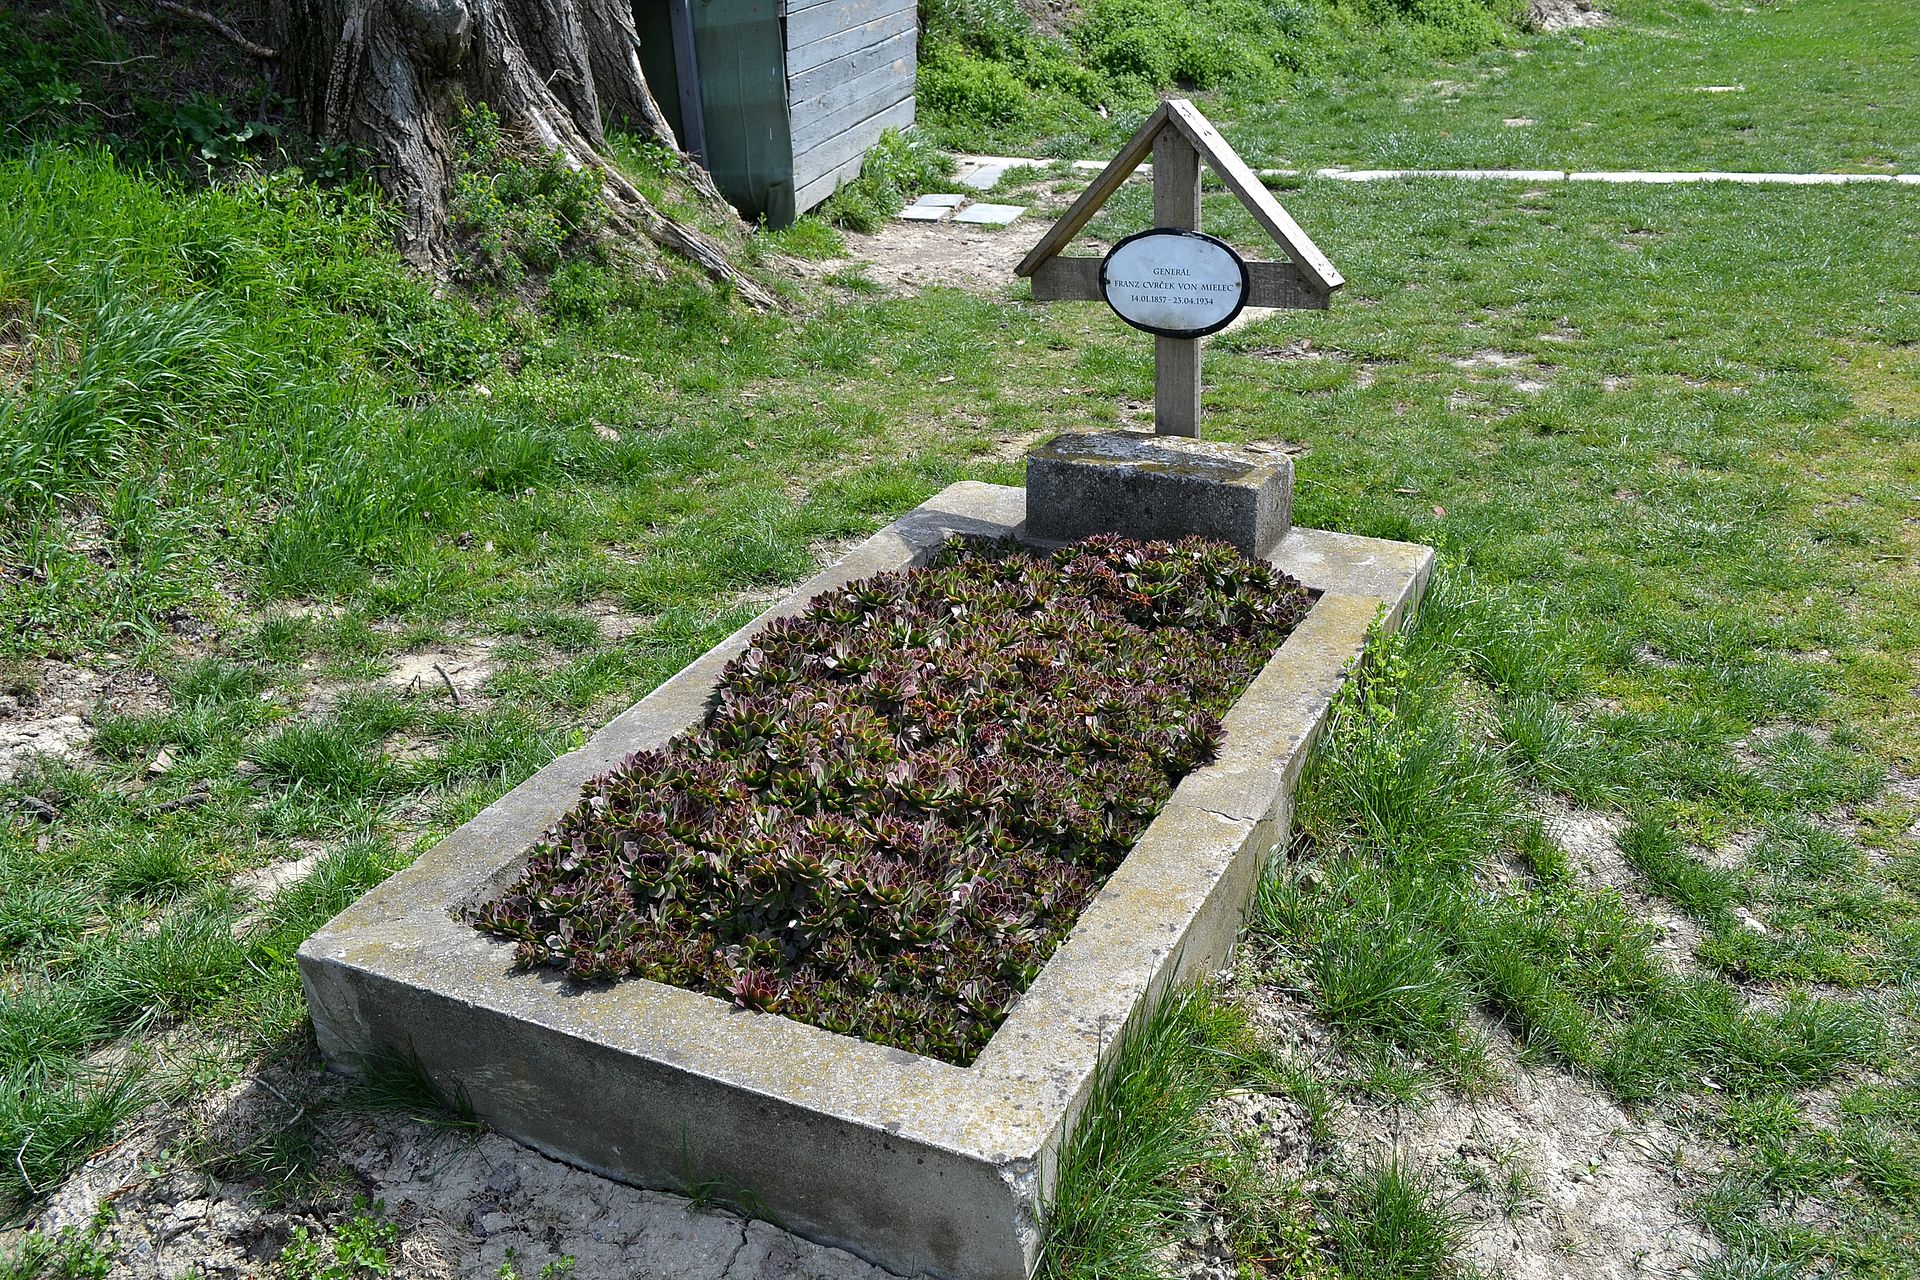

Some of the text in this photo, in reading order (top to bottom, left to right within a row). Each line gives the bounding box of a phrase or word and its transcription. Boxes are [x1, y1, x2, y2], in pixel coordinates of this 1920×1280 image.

[1114, 280, 1233, 292] FRANZ CVRČEK VON MIELEC
[1130, 294, 1167, 303] 14.01.1857
[1173, 296, 1213, 305] 23.04.1934
